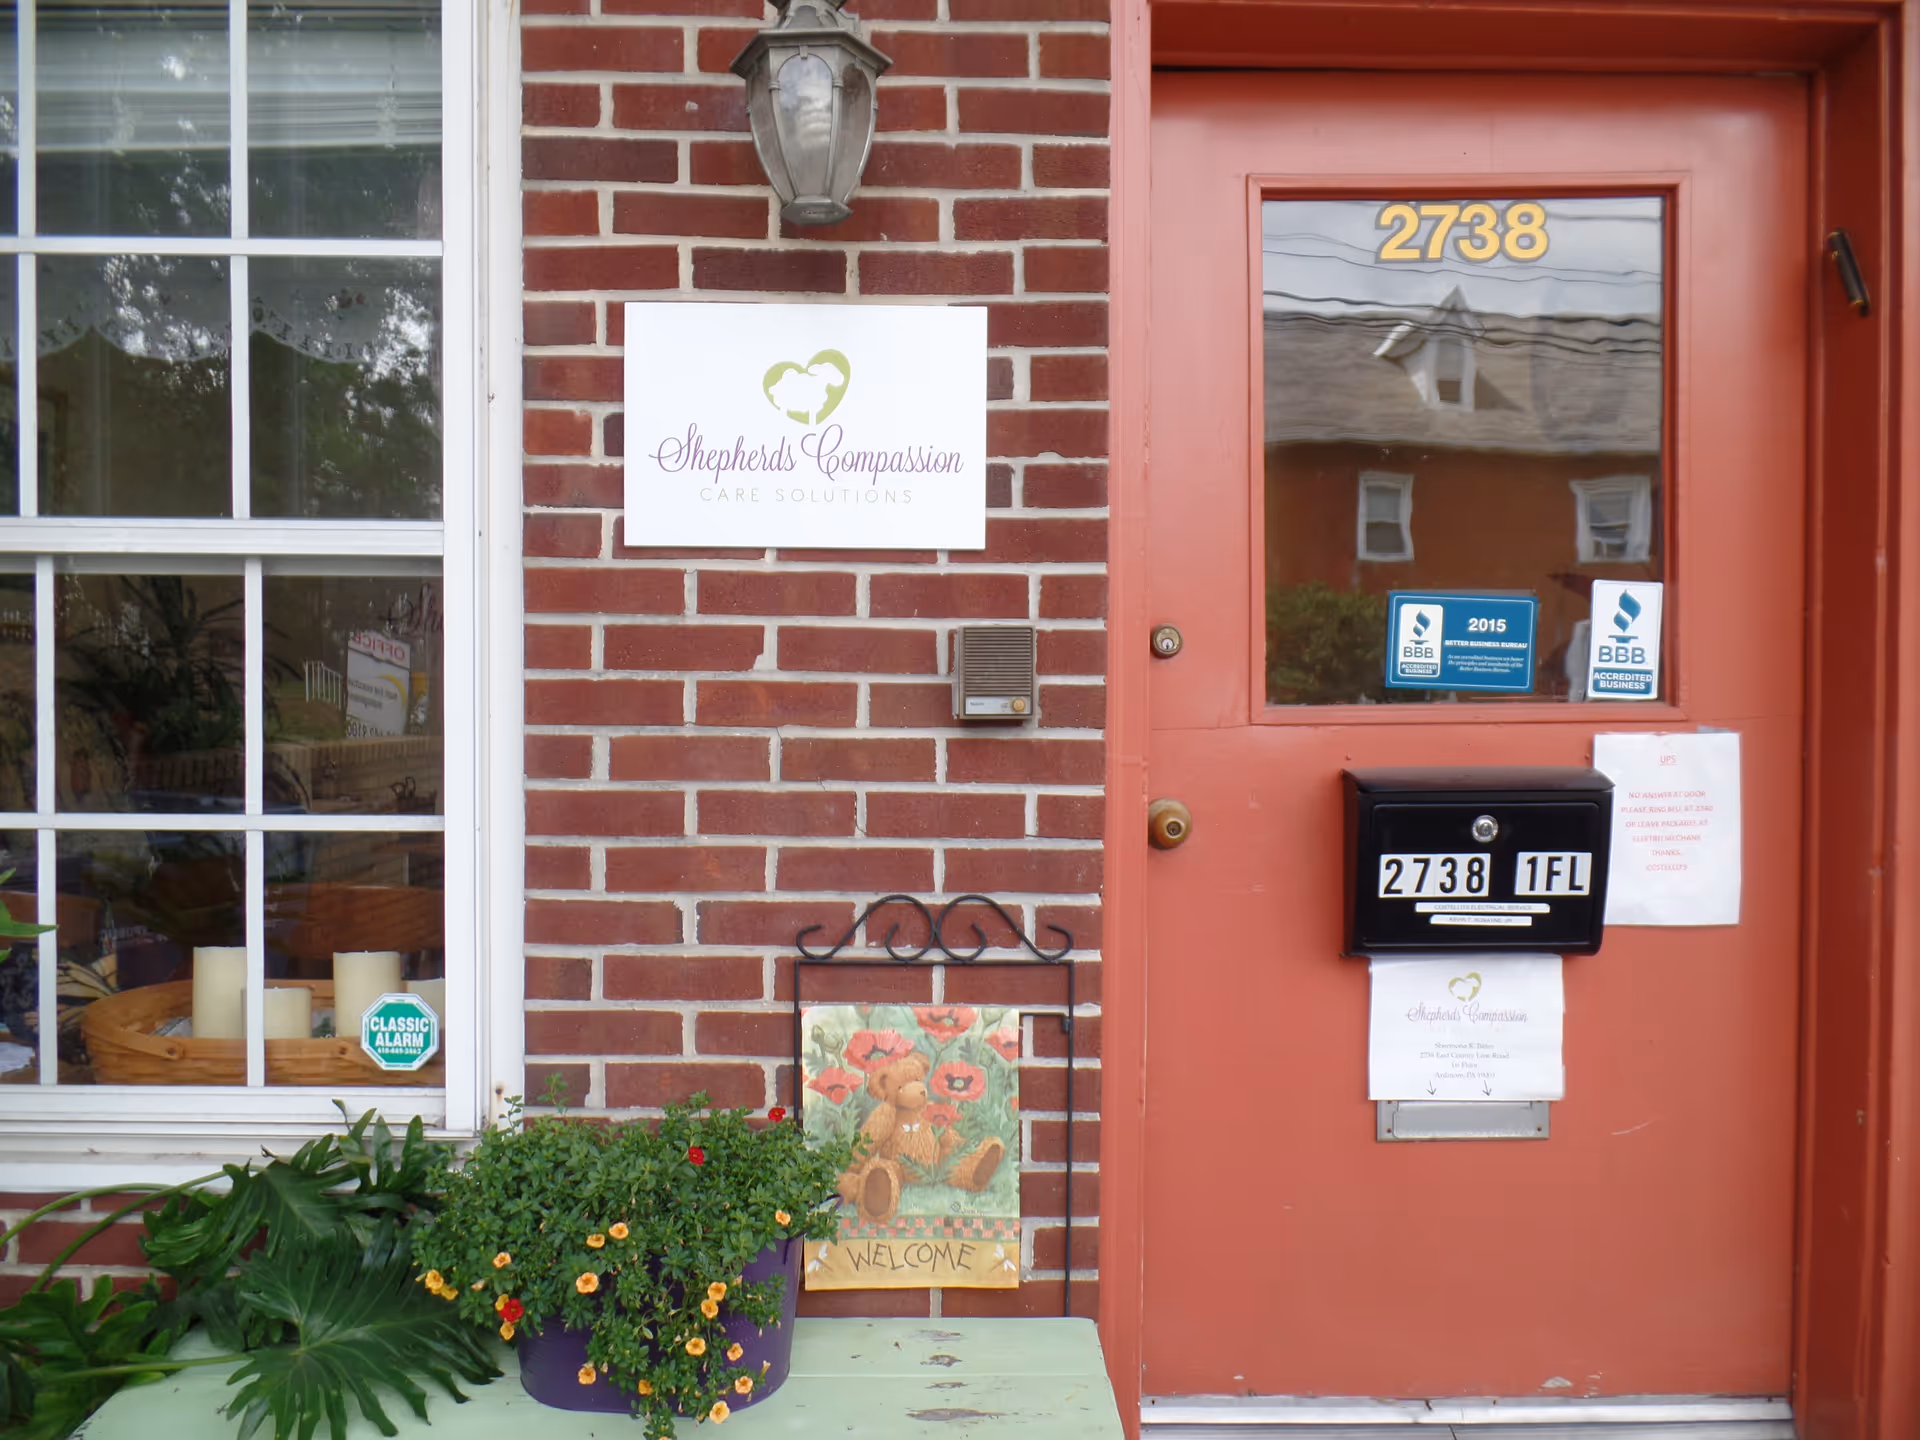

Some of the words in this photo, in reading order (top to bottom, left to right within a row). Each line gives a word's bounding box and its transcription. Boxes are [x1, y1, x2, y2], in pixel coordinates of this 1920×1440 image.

[1375, 200, 1549, 263] 2738
[648, 422, 797, 484] Shepherds
[800, 424, 964, 485] Compassion
[700, 487, 759, 501] CARE
[776, 488, 912, 503] SOLUTIONS
[1467, 617, 1507, 632] 2015
[1403, 646, 1433, 658] BBB
[1598, 645, 1646, 664] BBB
[1594, 672, 1653, 682] ACCREDITED
[1600, 681, 1646, 690] BUSINESS
[1383, 856, 1486, 895] 2738
[1526, 855, 1584, 892] 1FL
[1405, 1001, 1461, 1025] Shepherds
[1463, 1001, 1528, 1026] Compassion
[370, 1016, 429, 1032] CLASSIC
[375, 1032, 424, 1047] ALARM
[846, 1241, 976, 1272] WELCOME
